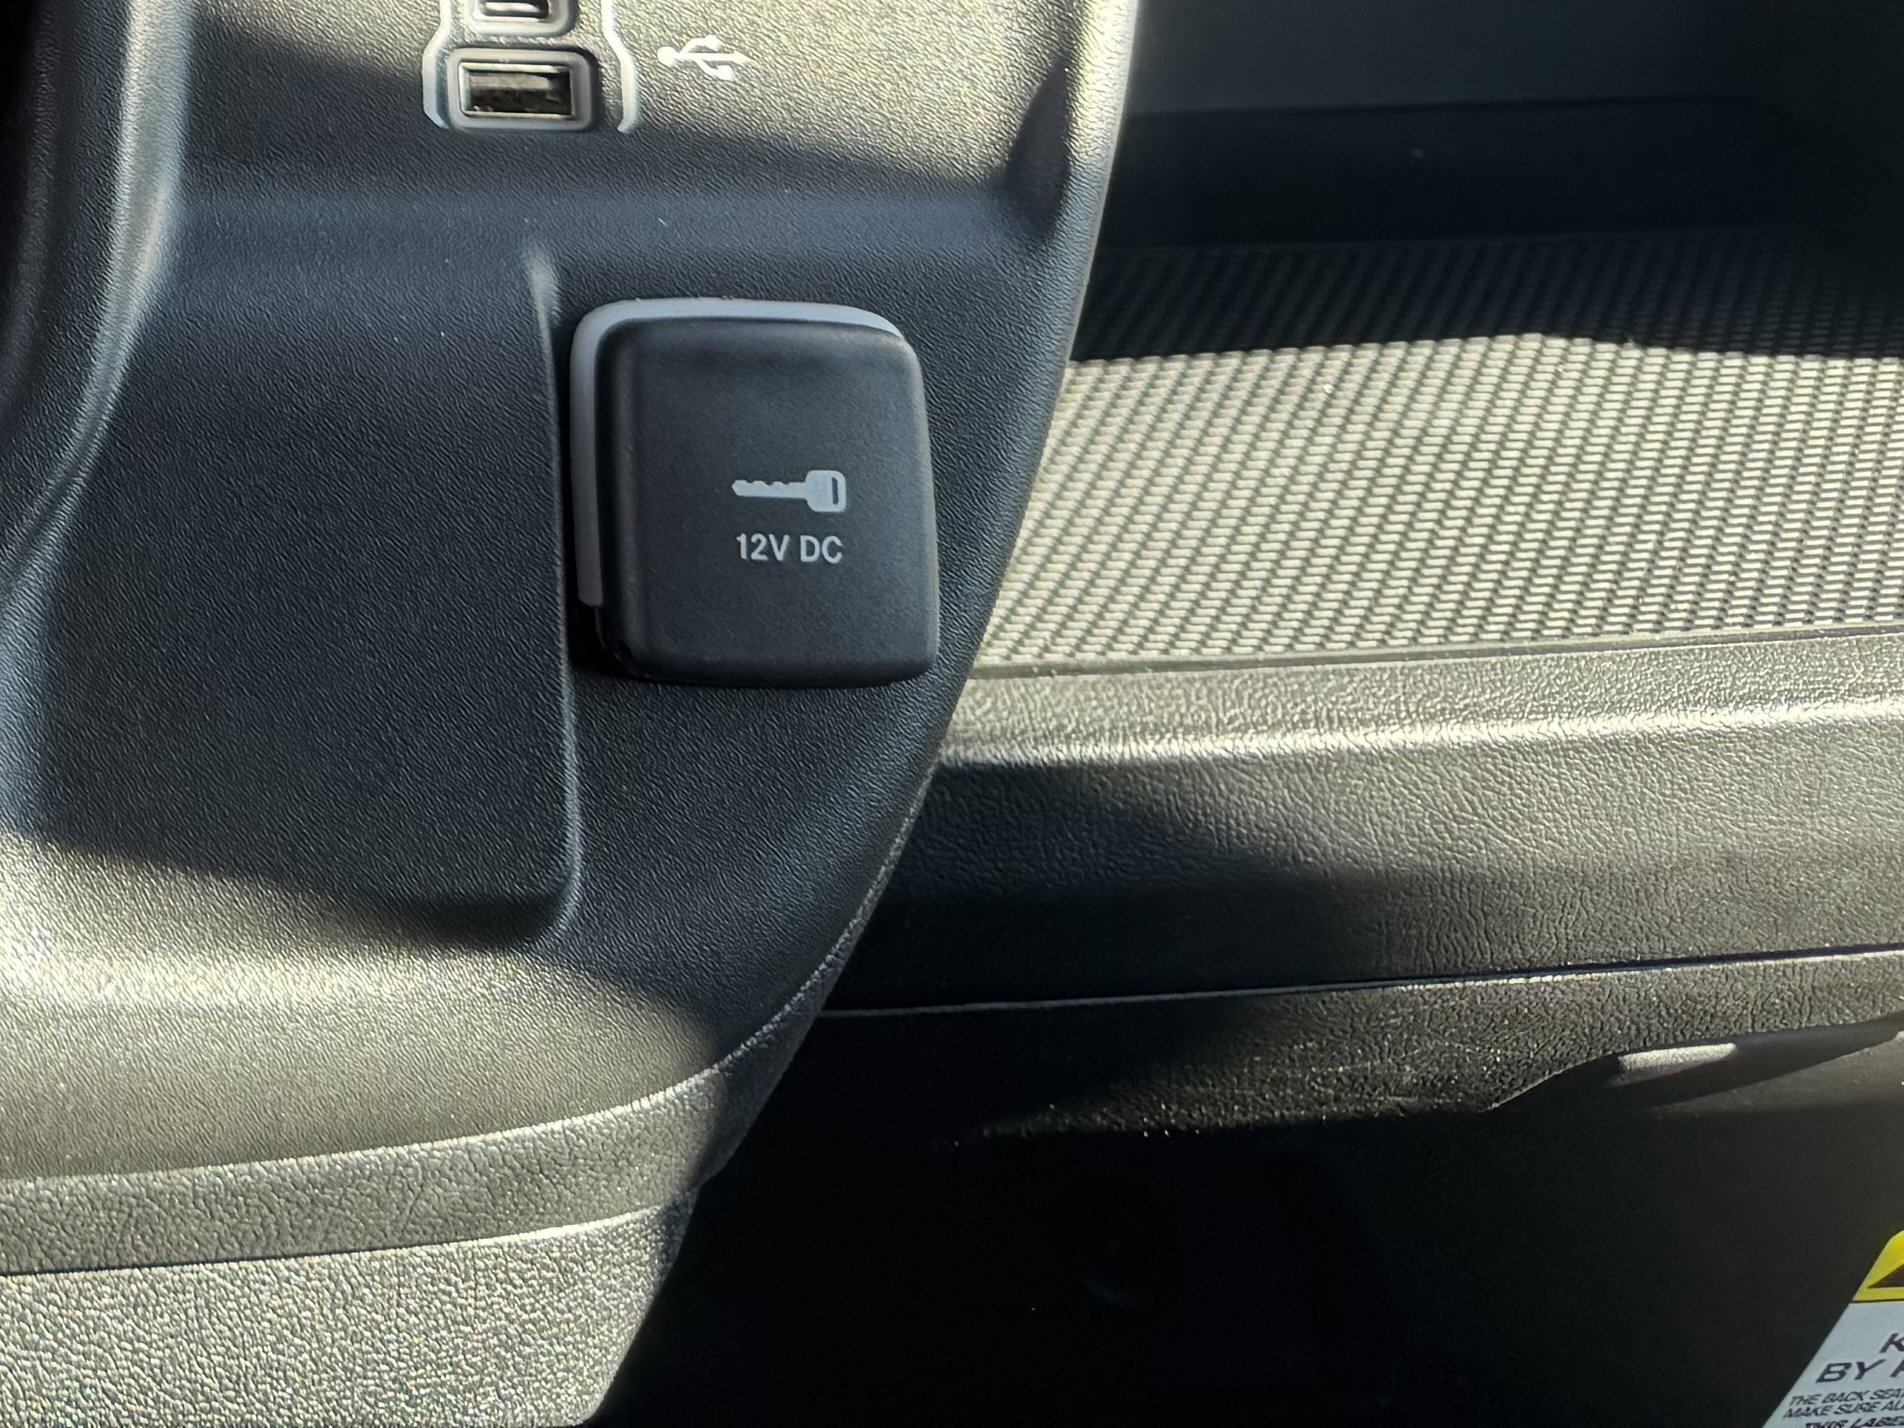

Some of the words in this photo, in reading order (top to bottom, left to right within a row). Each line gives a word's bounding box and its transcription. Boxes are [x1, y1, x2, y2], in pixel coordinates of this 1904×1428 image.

[735, 533, 789, 562] 12V
[801, 536, 843, 564] DC
[1816, 1359, 1887, 1383] BY
